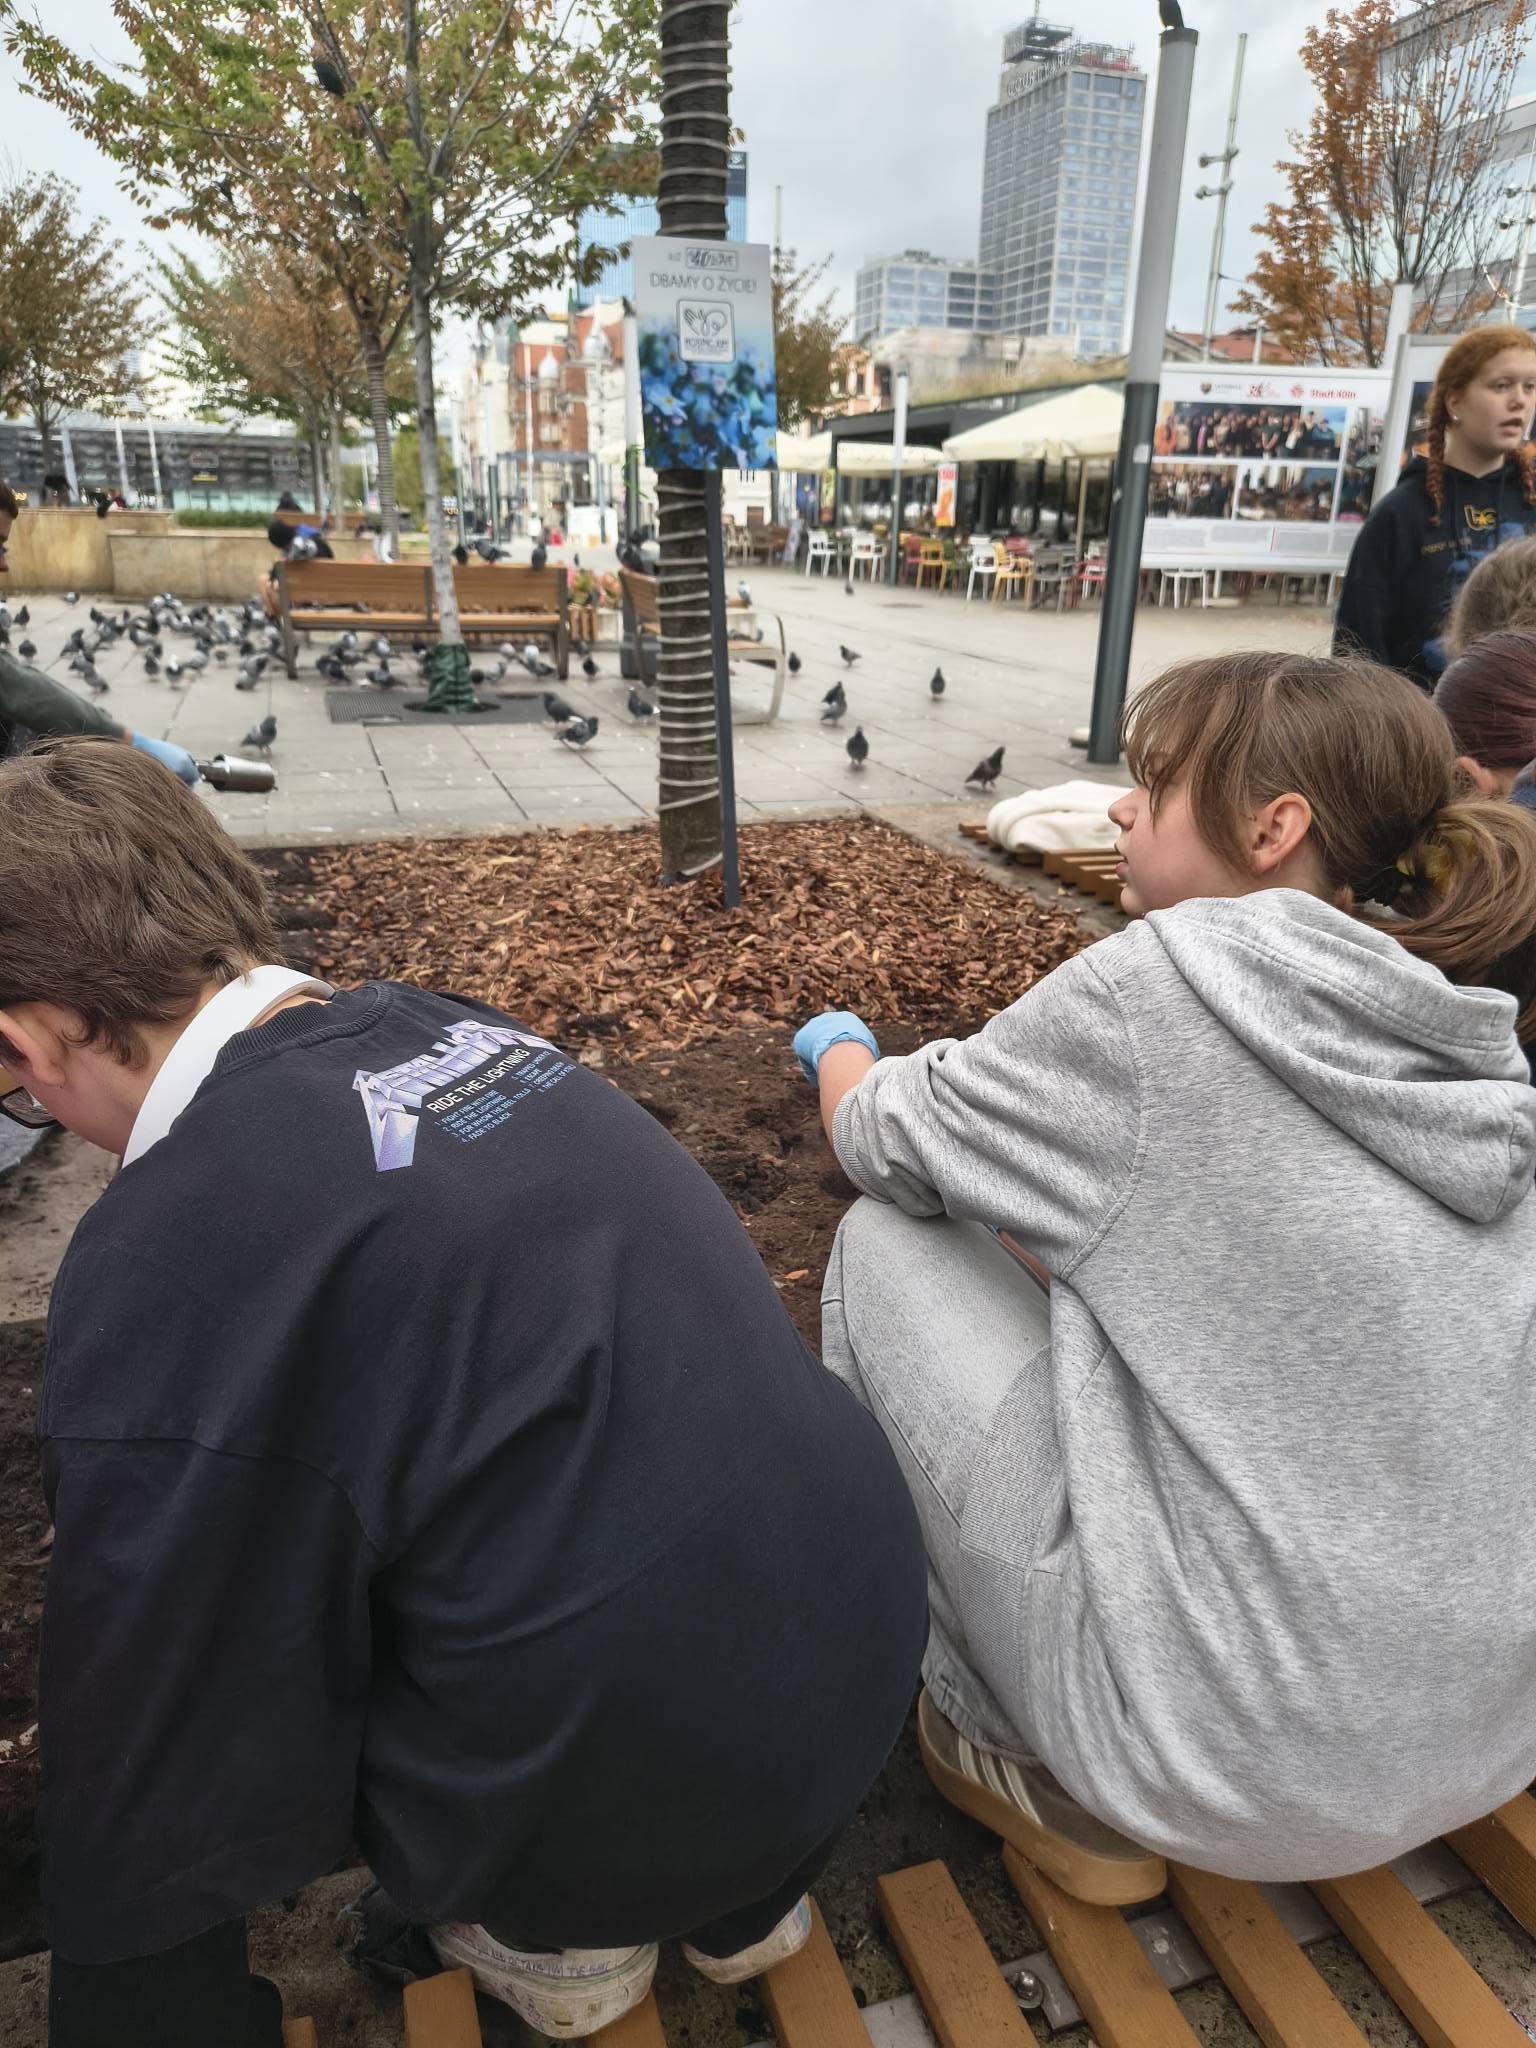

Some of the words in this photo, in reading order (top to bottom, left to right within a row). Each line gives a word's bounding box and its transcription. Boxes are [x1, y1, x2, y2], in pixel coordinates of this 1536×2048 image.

[650, 272, 699, 290] DBAMY
[702, 276, 715, 291] O
[426, 1092, 464, 1113] RIDE
[454, 1079, 486, 1096] THE
[478, 1048, 531, 1084] LIGHTNING
[441, 1111, 461, 1124] FIGHT
[451, 1118, 467, 1129] RIDE
[466, 1111, 478, 1120] THE
[459, 1123, 473, 1134] FOR
[471, 1112, 493, 1128] WHOM
[490, 1106, 504, 1115] THE
[468, 1127, 487, 1140] FADE
[484, 1122, 495, 1130] TO
[492, 1111, 513, 1125] BLACK
